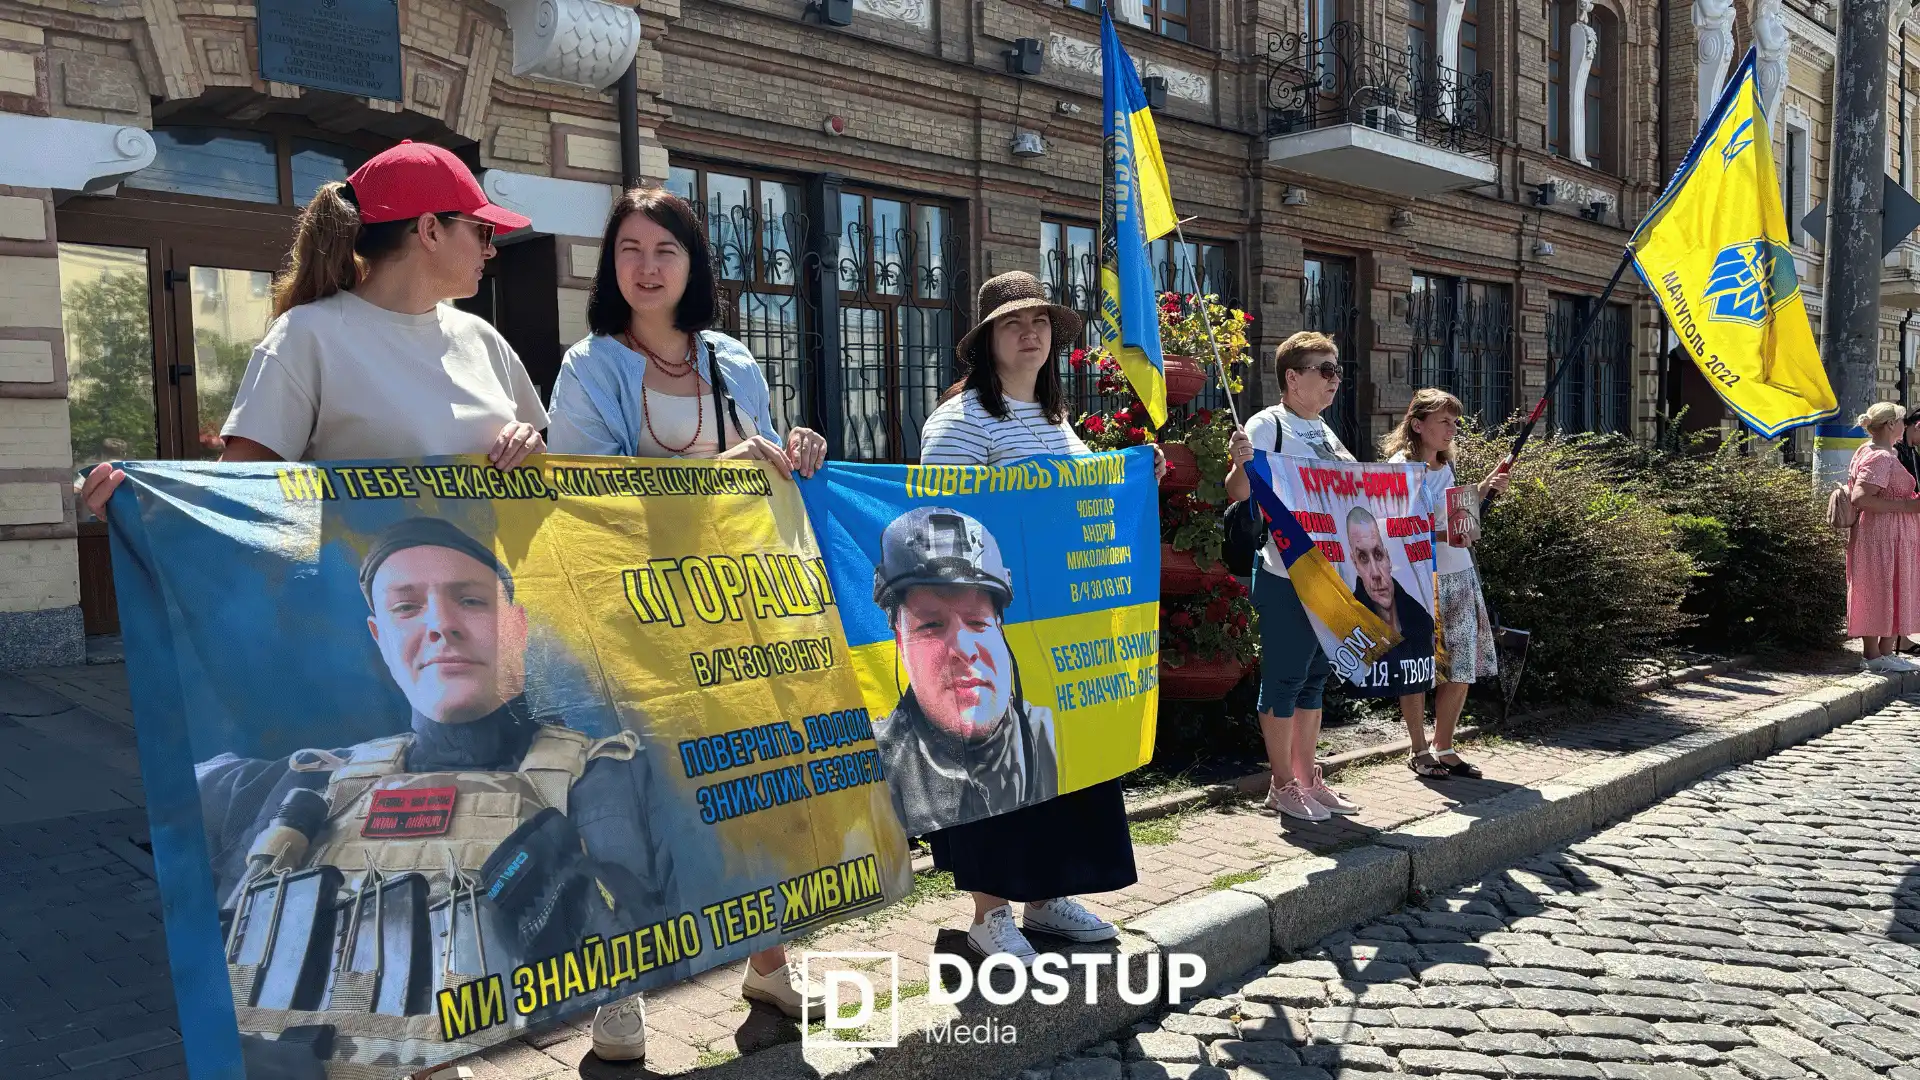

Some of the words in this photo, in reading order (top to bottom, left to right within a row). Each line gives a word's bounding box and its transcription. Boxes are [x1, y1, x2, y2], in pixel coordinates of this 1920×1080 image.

[1662, 270, 1705, 358] МАРІУПОЛЬ
[1705, 354, 1740, 388] 2022
[275, 467, 339, 500] МИ
[333, 467, 420, 499] ТЕБЕ
[414, 465, 558, 500] ЧЕКАЄМО,
[553, 467, 600, 497] МИ
[596, 467, 661, 497] ТЕБЕ
[656, 467, 773, 496] ШУКАЄМО!
[905, 461, 1053, 498] ПОВЕРНИСЬ
[1049, 454, 1126, 488] ЖИВИМ!
[1076, 498, 1115, 518] ЧОБОТАР
[1083, 520, 1116, 543] АНДРІЙ
[1067, 546, 1132, 570] МИКОЛАЙОВИЧ
[1070, 582, 1090, 602] В/Ч
[1114, 576, 1132, 595] НГУ
[690, 648, 741, 686] В/Ч
[739, 641, 797, 678] 3018
[793, 636, 834, 671] НГУ
[1051, 637, 1117, 673] БЕЗВІСТИ
[1117, 629, 1160, 660] ЗНИКЛ
[1400, 657, 1430, 685] ТВОЯ
[1056, 683, 1077, 712] НЕ
[1076, 671, 1137, 708] ЗНАЧИТЬ
[678, 721, 805, 778] ПОВЕРНІТЬ
[803, 707, 875, 754] ДОДОМ
[696, 764, 812, 825] ЗНИКЛИХ
[437, 974, 506, 1042] МИ
[510, 912, 702, 1016] ЗНАЙДЕМО
[701, 887, 776, 950] ТЕБЕ
[778, 854, 882, 926] ЖИВИМ
